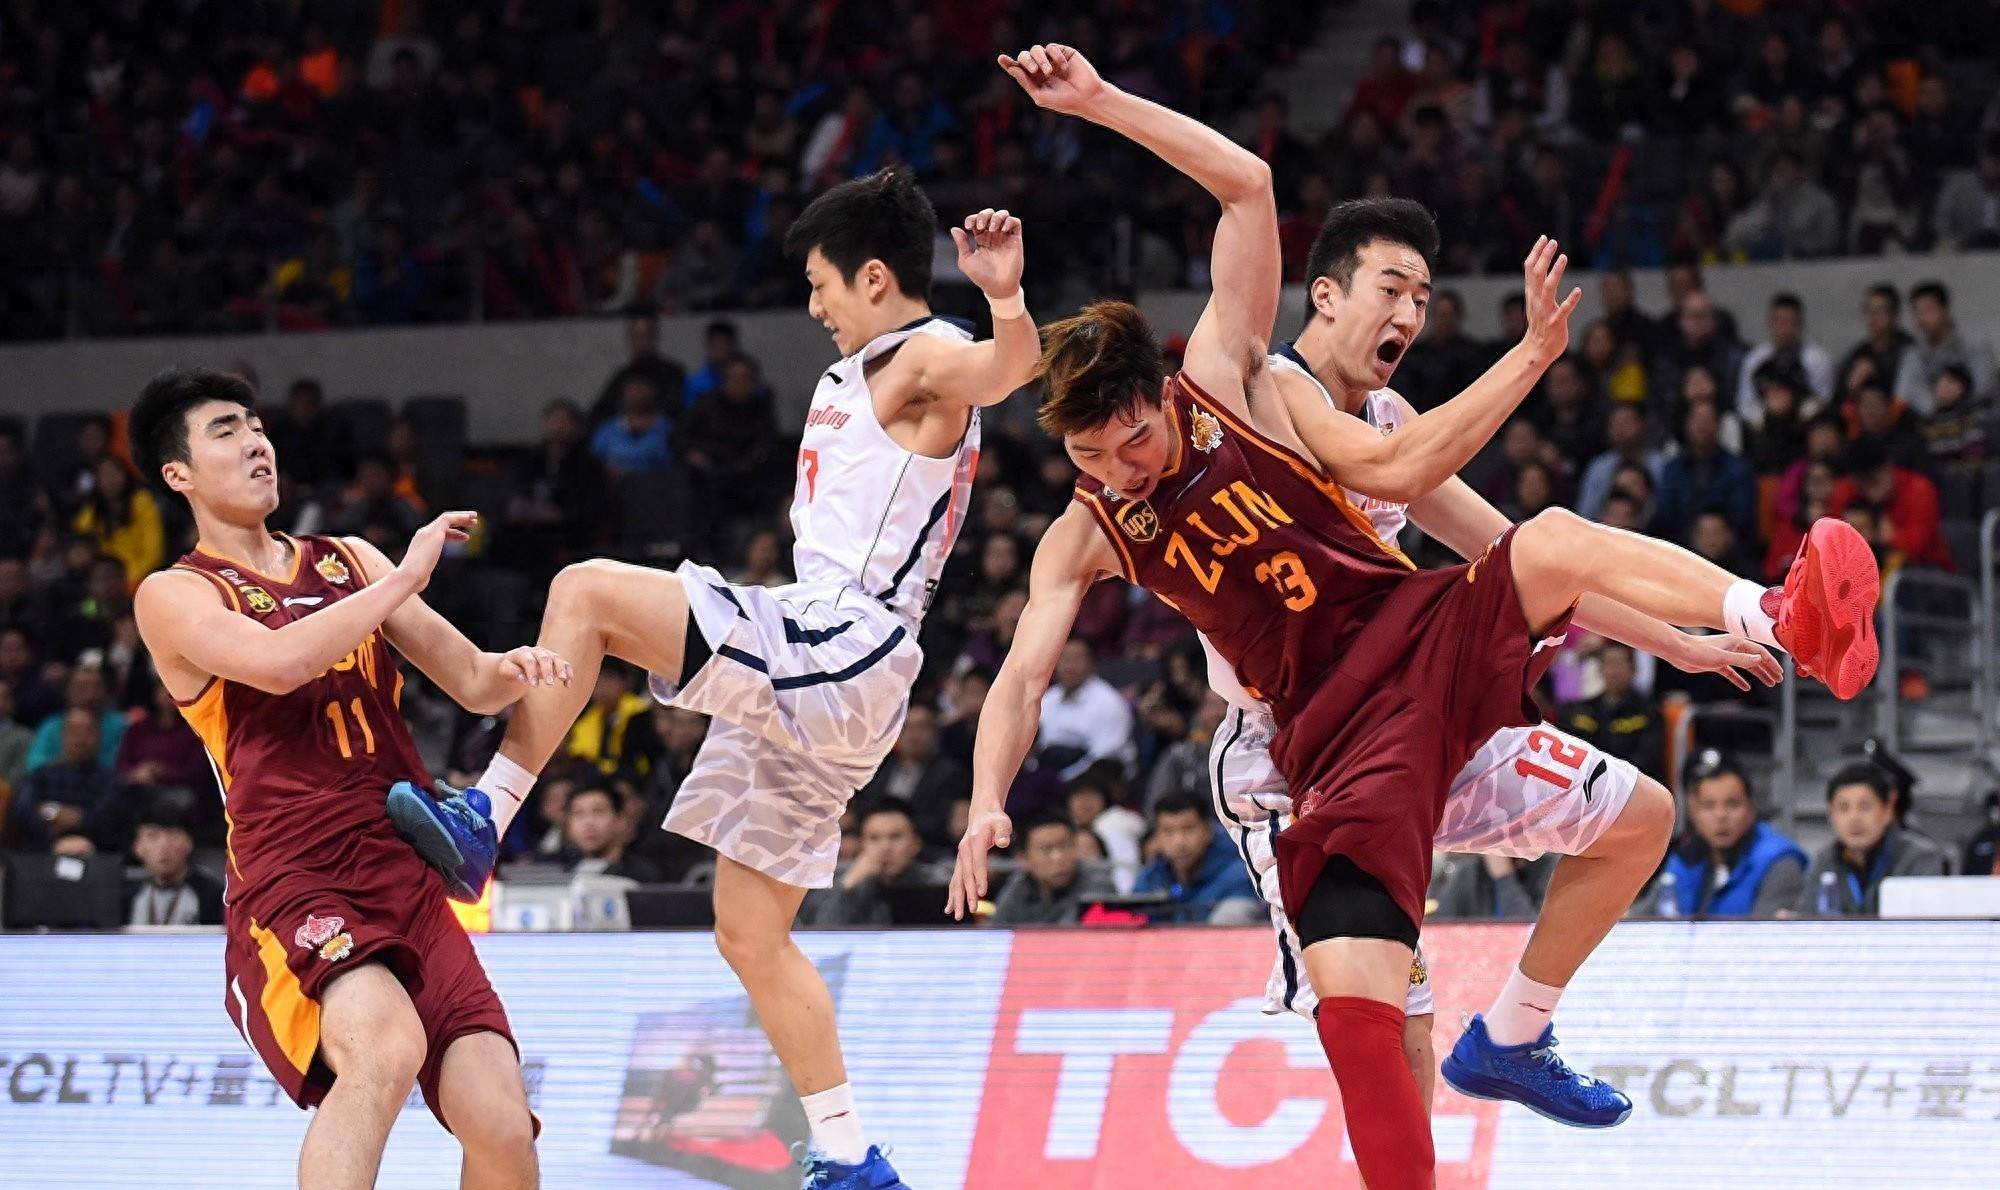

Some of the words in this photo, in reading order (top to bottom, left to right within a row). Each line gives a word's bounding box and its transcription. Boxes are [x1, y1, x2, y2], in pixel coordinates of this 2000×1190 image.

[1123, 507, 1154, 536] ups
[1164, 480, 1294, 595] ZJJN
[326, 697, 375, 758] 11
[1514, 730, 1589, 790] 12
[0, 1053, 202, 1104] CLTV+
